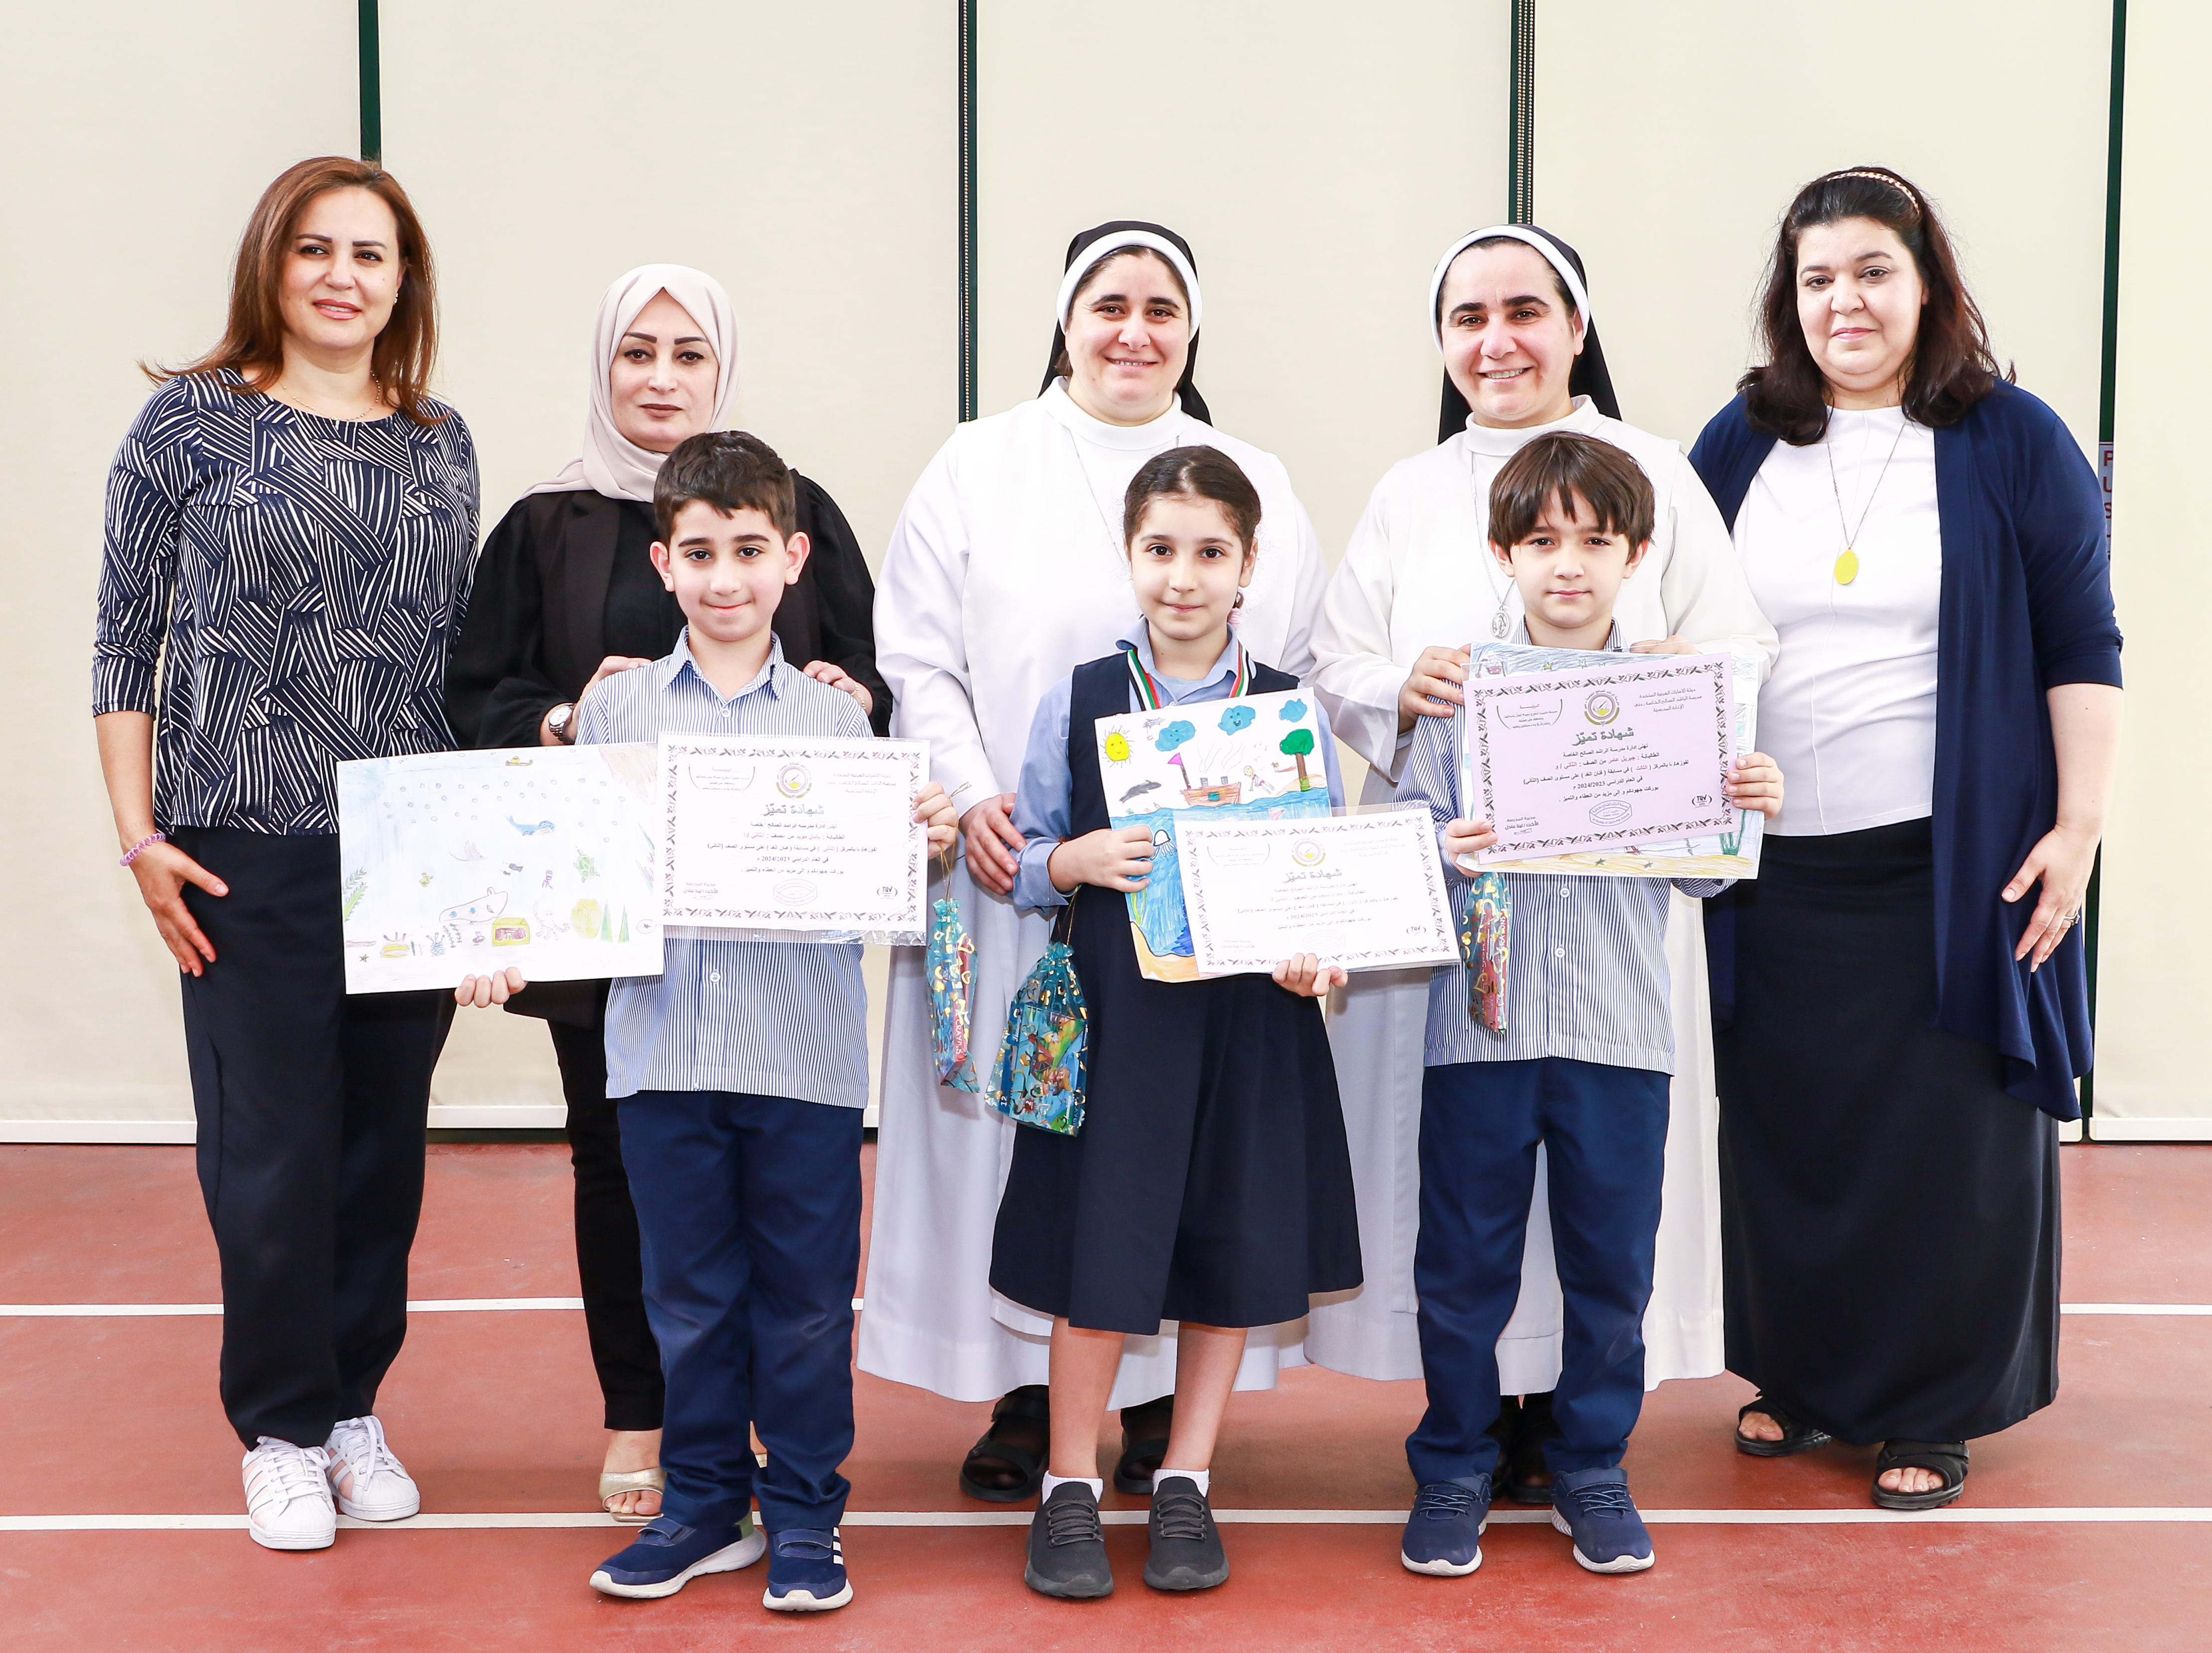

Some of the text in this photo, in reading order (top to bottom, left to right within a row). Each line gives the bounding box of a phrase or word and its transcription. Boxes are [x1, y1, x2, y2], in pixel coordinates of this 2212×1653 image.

[2103, 450, 2113, 538] PUS
[1572, 727, 1634, 747] شهادة تميّز
[762, 802, 824, 817] شهادة تميّز
[1282, 868, 1342, 884] شهادة تميّز
[1000, 1096, 1007, 1107] 12
